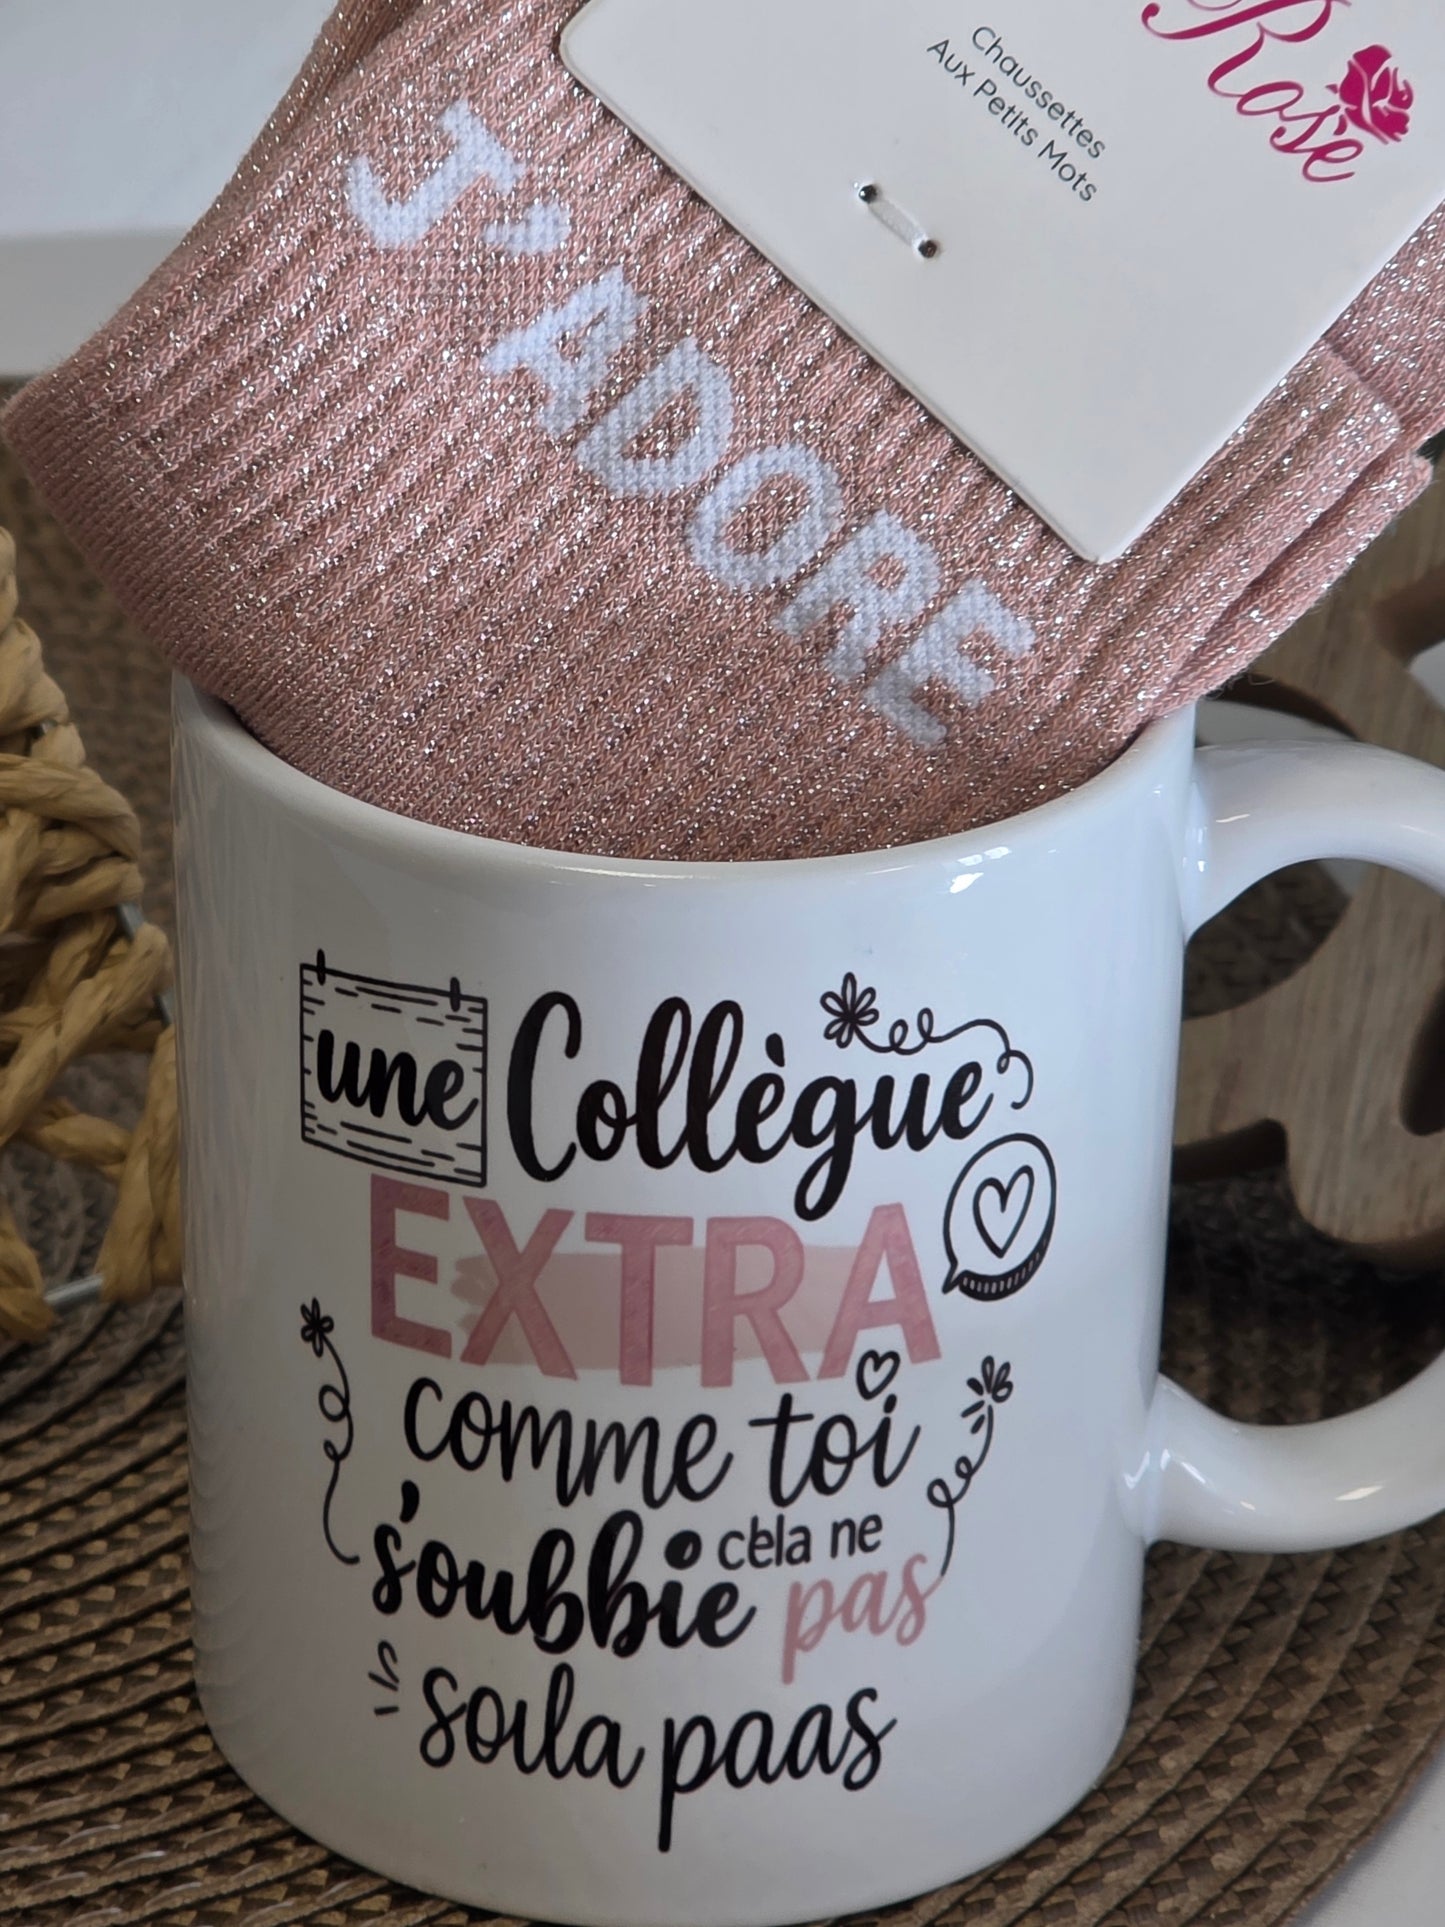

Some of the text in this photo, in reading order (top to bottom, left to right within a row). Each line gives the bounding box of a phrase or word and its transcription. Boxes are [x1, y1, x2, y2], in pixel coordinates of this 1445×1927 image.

[926, 39, 1097, 201] Aux Petits Mots
[972, 26, 1105, 158] Chaussettes
[317, 992, 992, 1221] une Collègue
[370, 1173, 941, 1387] EXTRA
[404, 1377, 920, 1509] comme toi
[830, 1514, 882, 1559] ne
[781, 1553, 942, 1685] pas
[658, 1688, 897, 1852] paas
